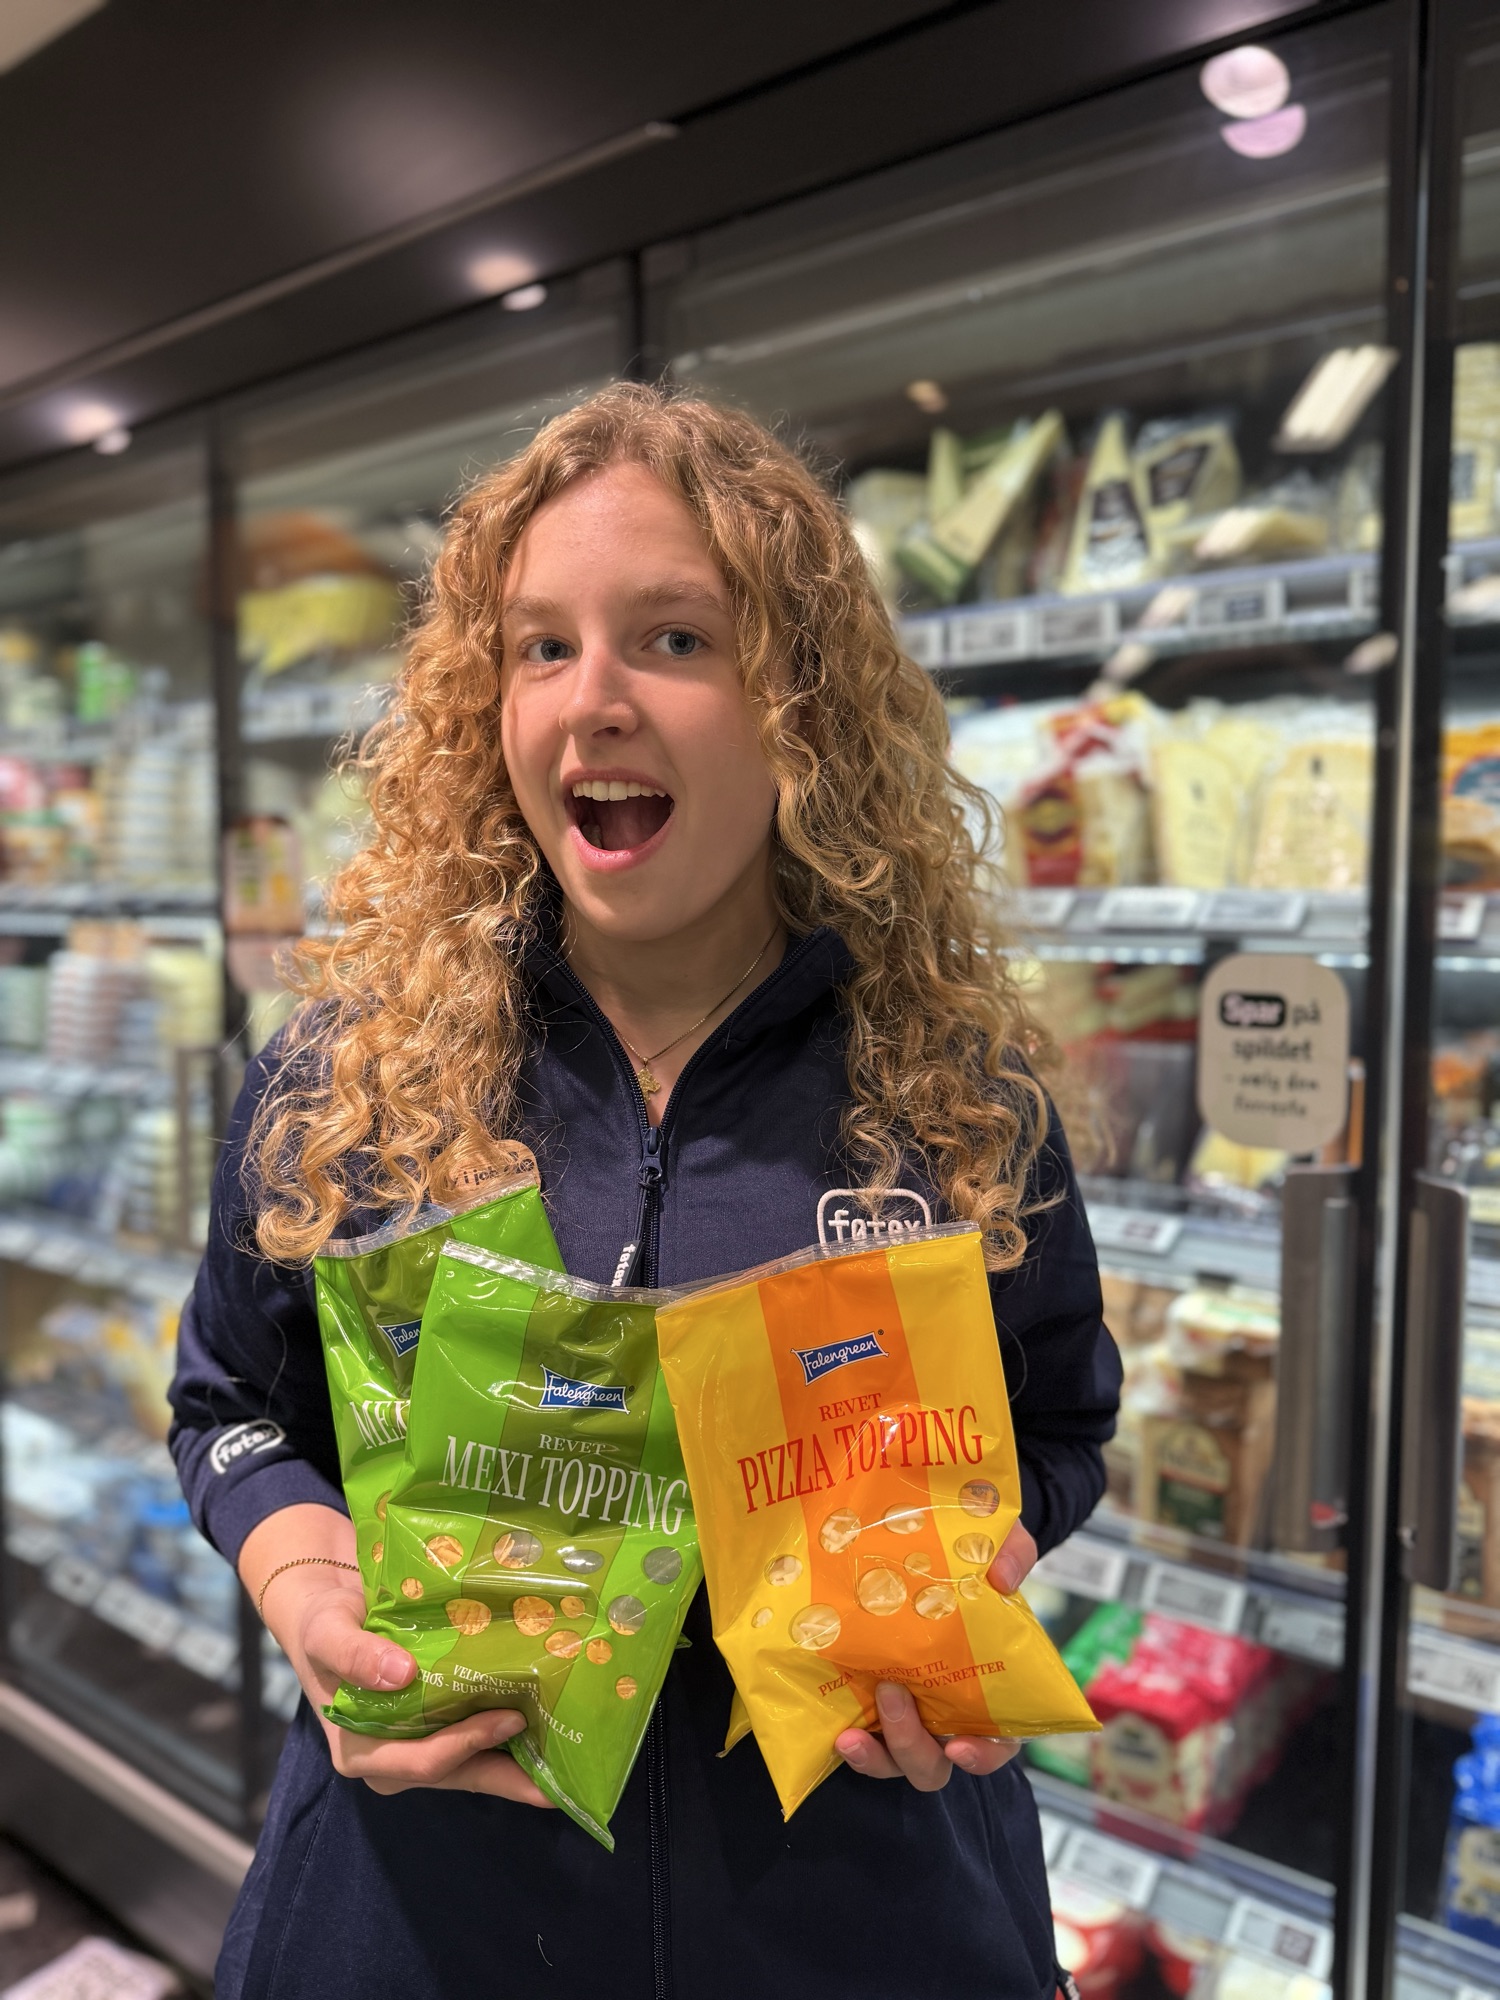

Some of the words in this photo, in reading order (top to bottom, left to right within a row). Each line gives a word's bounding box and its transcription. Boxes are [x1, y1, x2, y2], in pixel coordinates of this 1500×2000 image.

[803, 1340, 877, 1378] Falengreen
[545, 1374, 622, 1406] Falengreen
[818, 1392, 882, 1422] REVET
[538, 1433, 606, 1455] REVET
[737, 1434, 837, 1514] PIZZA
[834, 1405, 984, 1481] TOPPING
[438, 1434, 533, 1503] MEXI
[538, 1457, 689, 1536] TOPPING
[453, 1665, 516, 1690] VELEGNET
[517, 1681, 539, 1695] TIL
[818, 1671, 854, 1697] PIZZA
[923, 1660, 1006, 1689] OVNRETTER
[924, 1660, 949, 1675] TIL
[452, 1680, 518, 1695] BURRITOS
